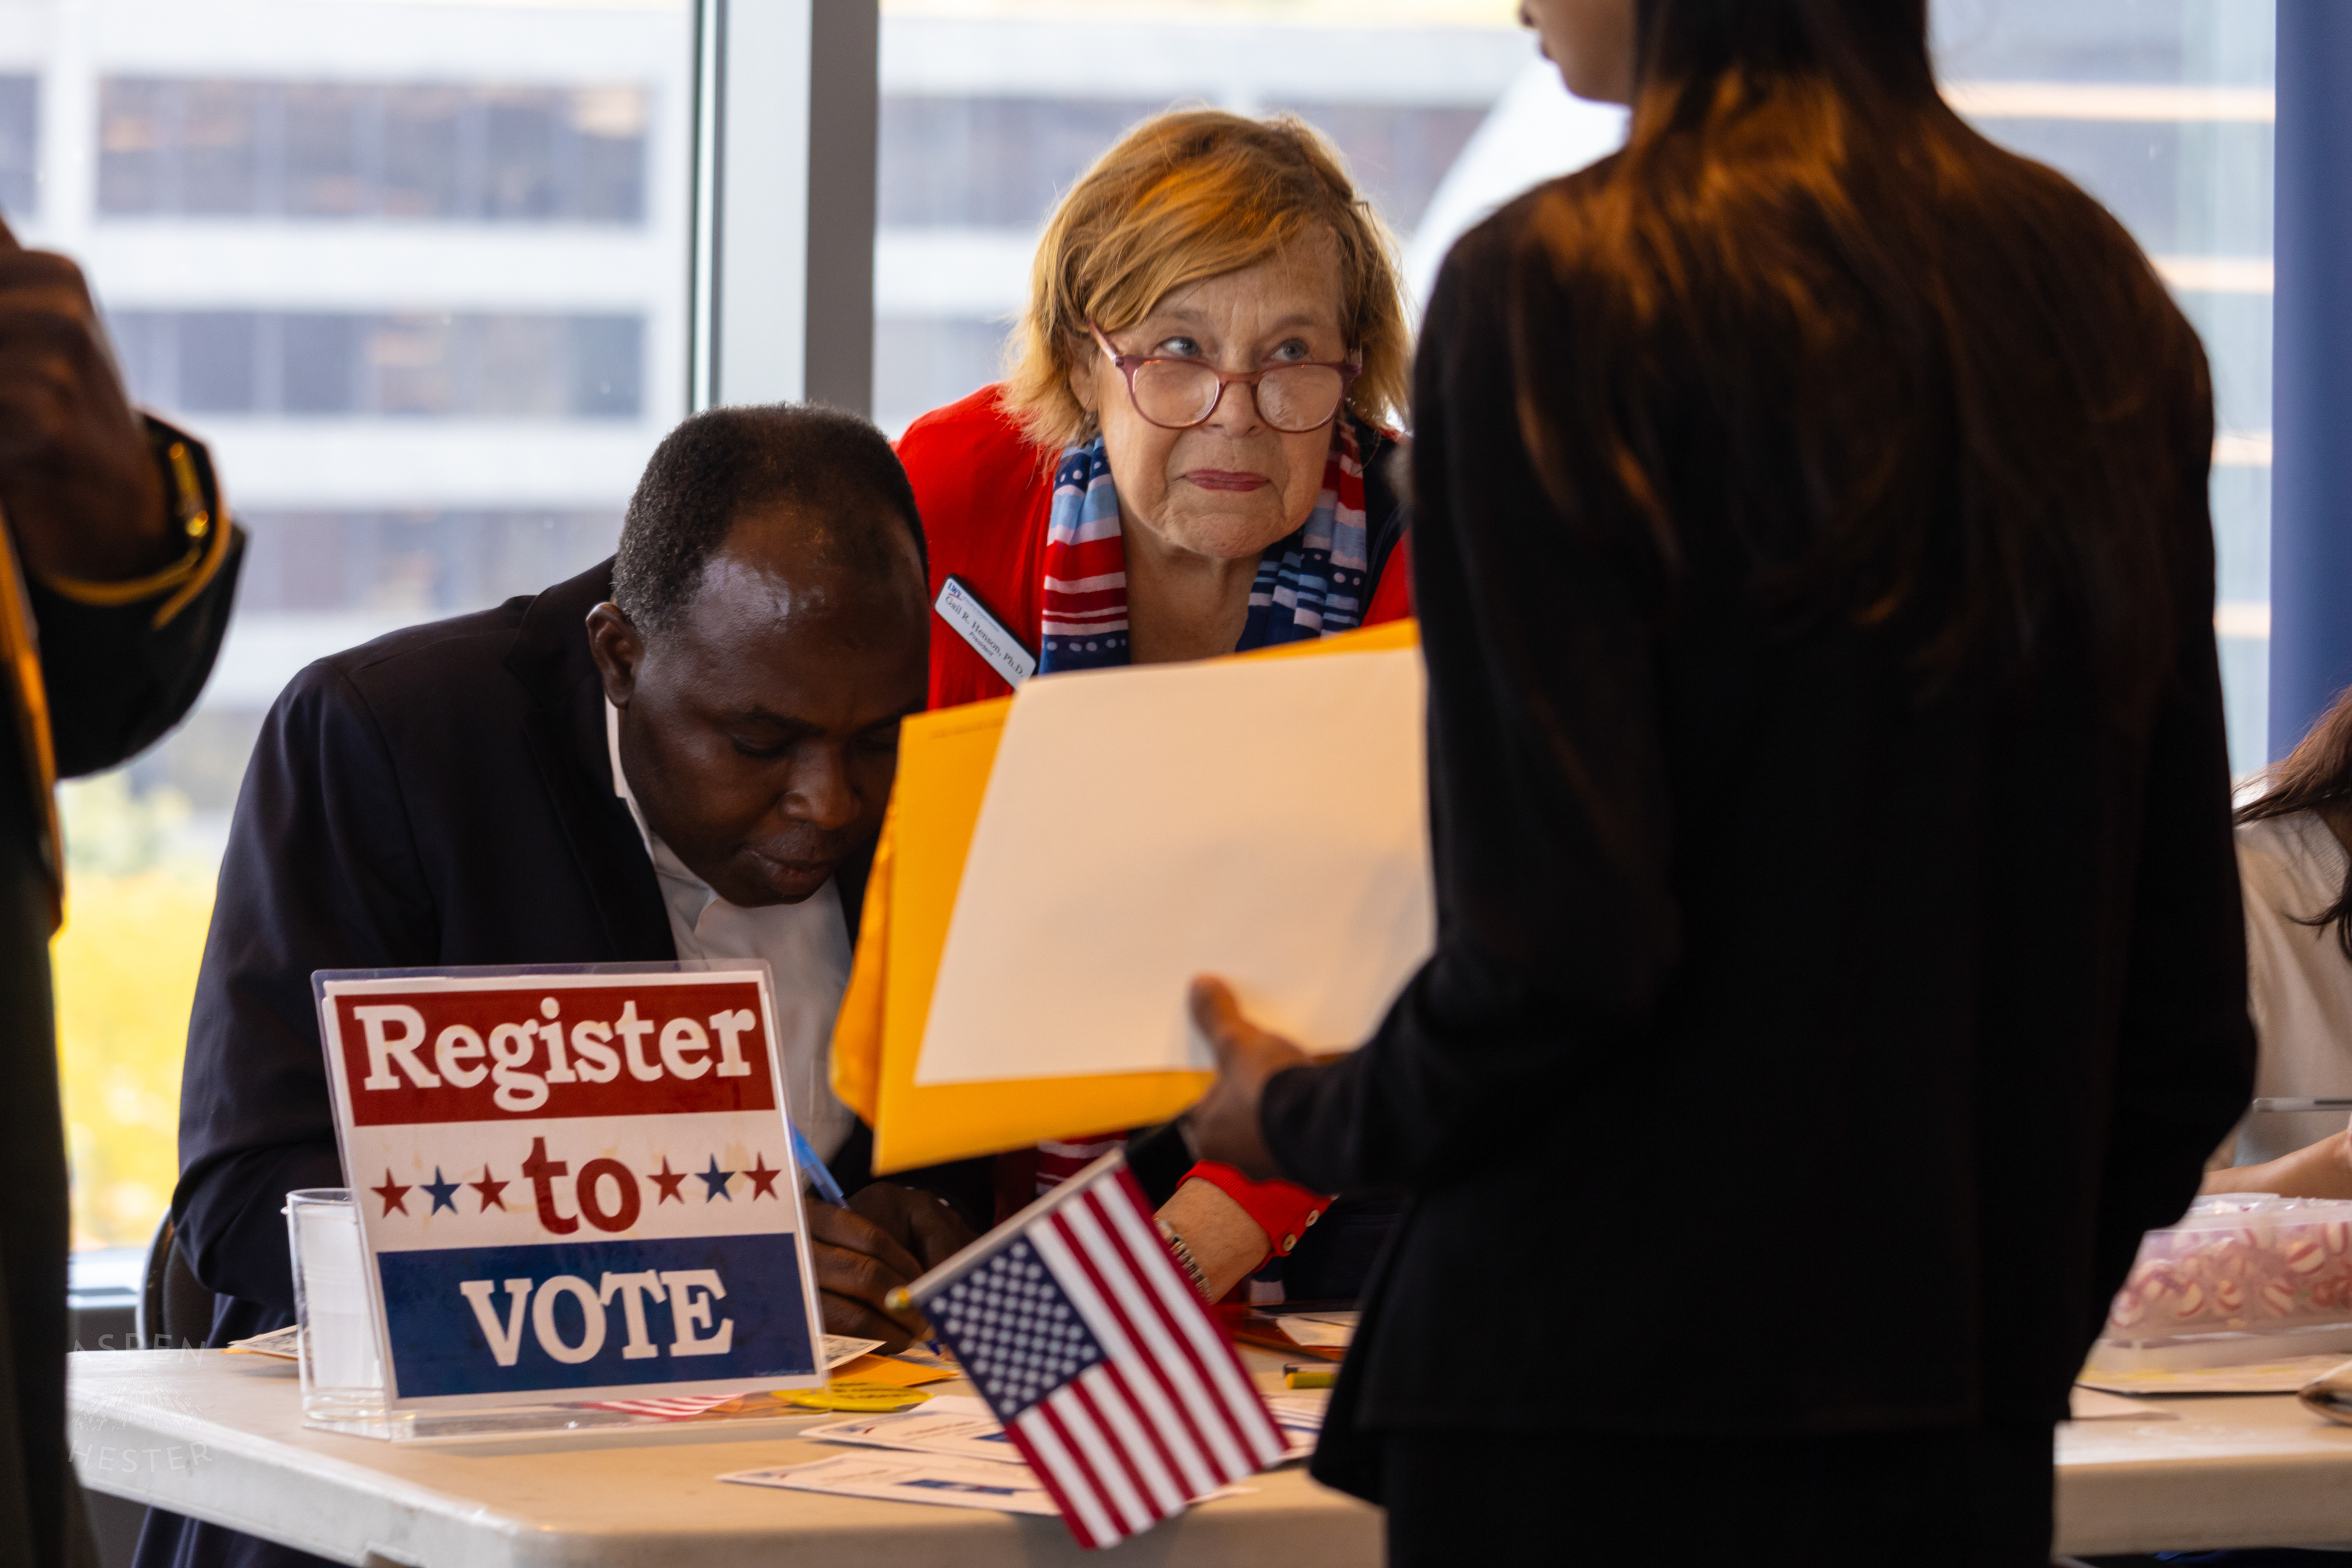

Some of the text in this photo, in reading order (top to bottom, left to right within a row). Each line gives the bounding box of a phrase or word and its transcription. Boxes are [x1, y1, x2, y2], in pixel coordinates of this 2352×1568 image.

[945, 596, 962, 614] Gail
[962, 612, 970, 624] R.
[971, 620, 1002, 657] Henson,
[1003, 652, 1023, 677] Ph.D.
[969, 631, 994, 657] President
[353, 997, 756, 1112] Register
[522, 1136, 641, 1235] to
[459, 1269, 734, 1367] VOTE
